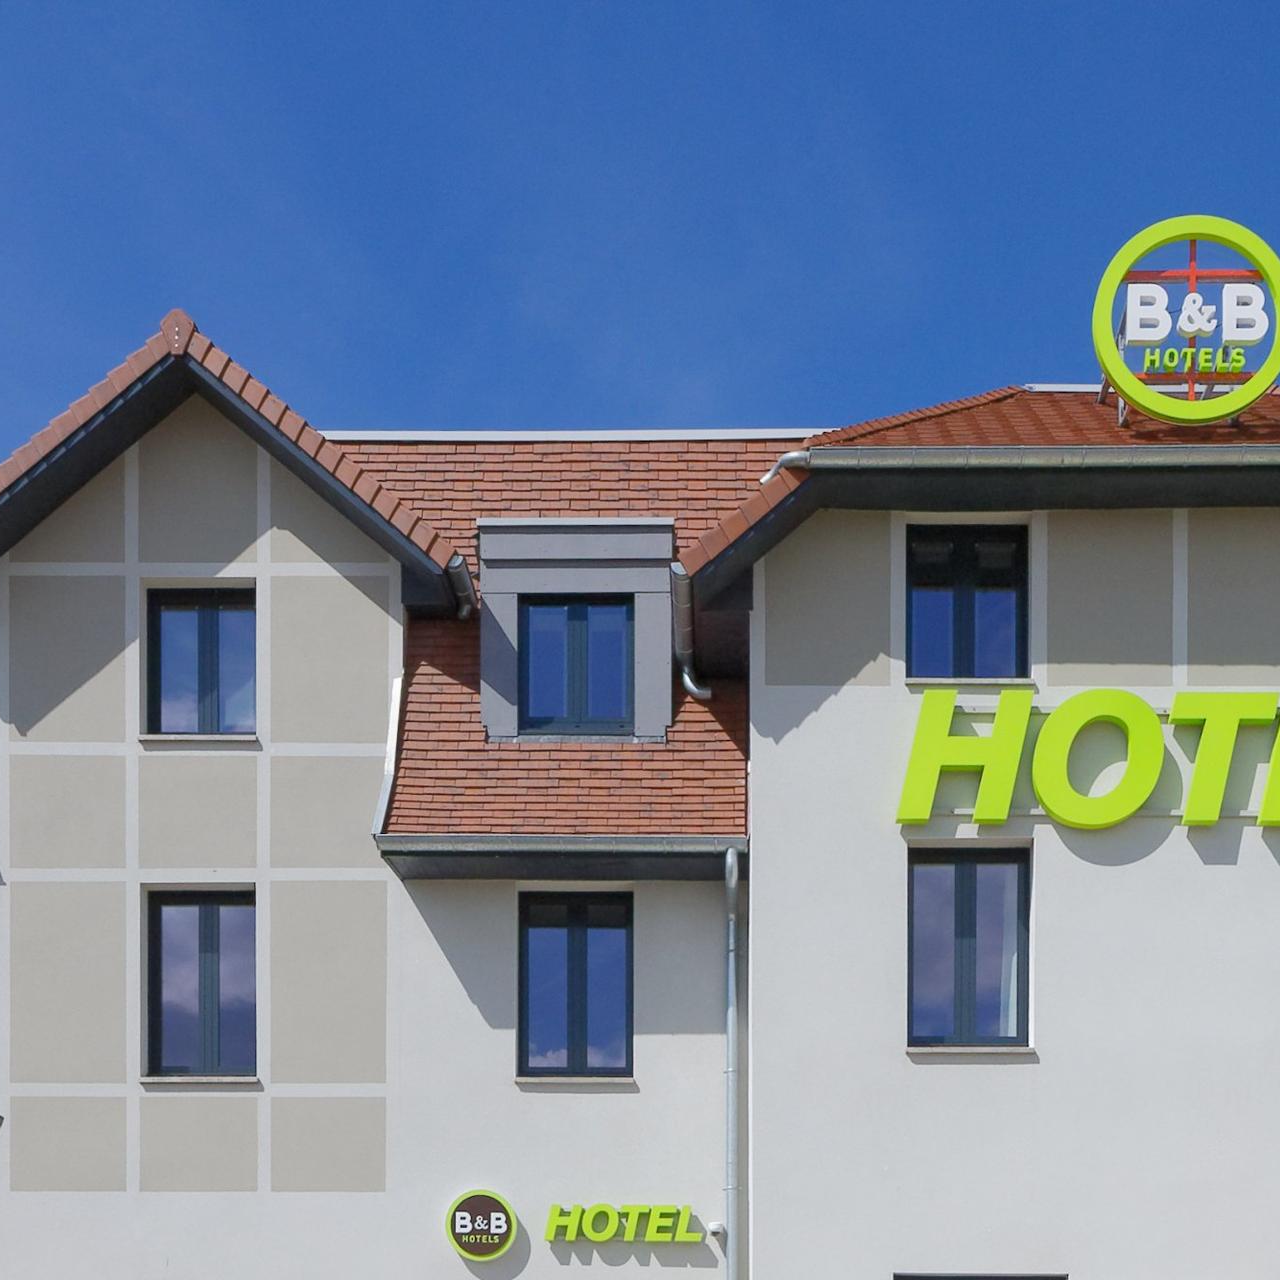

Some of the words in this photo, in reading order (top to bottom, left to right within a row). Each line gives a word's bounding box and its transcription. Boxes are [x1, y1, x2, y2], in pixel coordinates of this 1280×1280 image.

[1126, 283, 1269, 345] B&B
[1144, 347, 1247, 372] HOTELS
[455, 1211, 508, 1234] B&B
[544, 1204, 703, 1243] HOTEL
[462, 1234, 500, 1244] HOTELS
